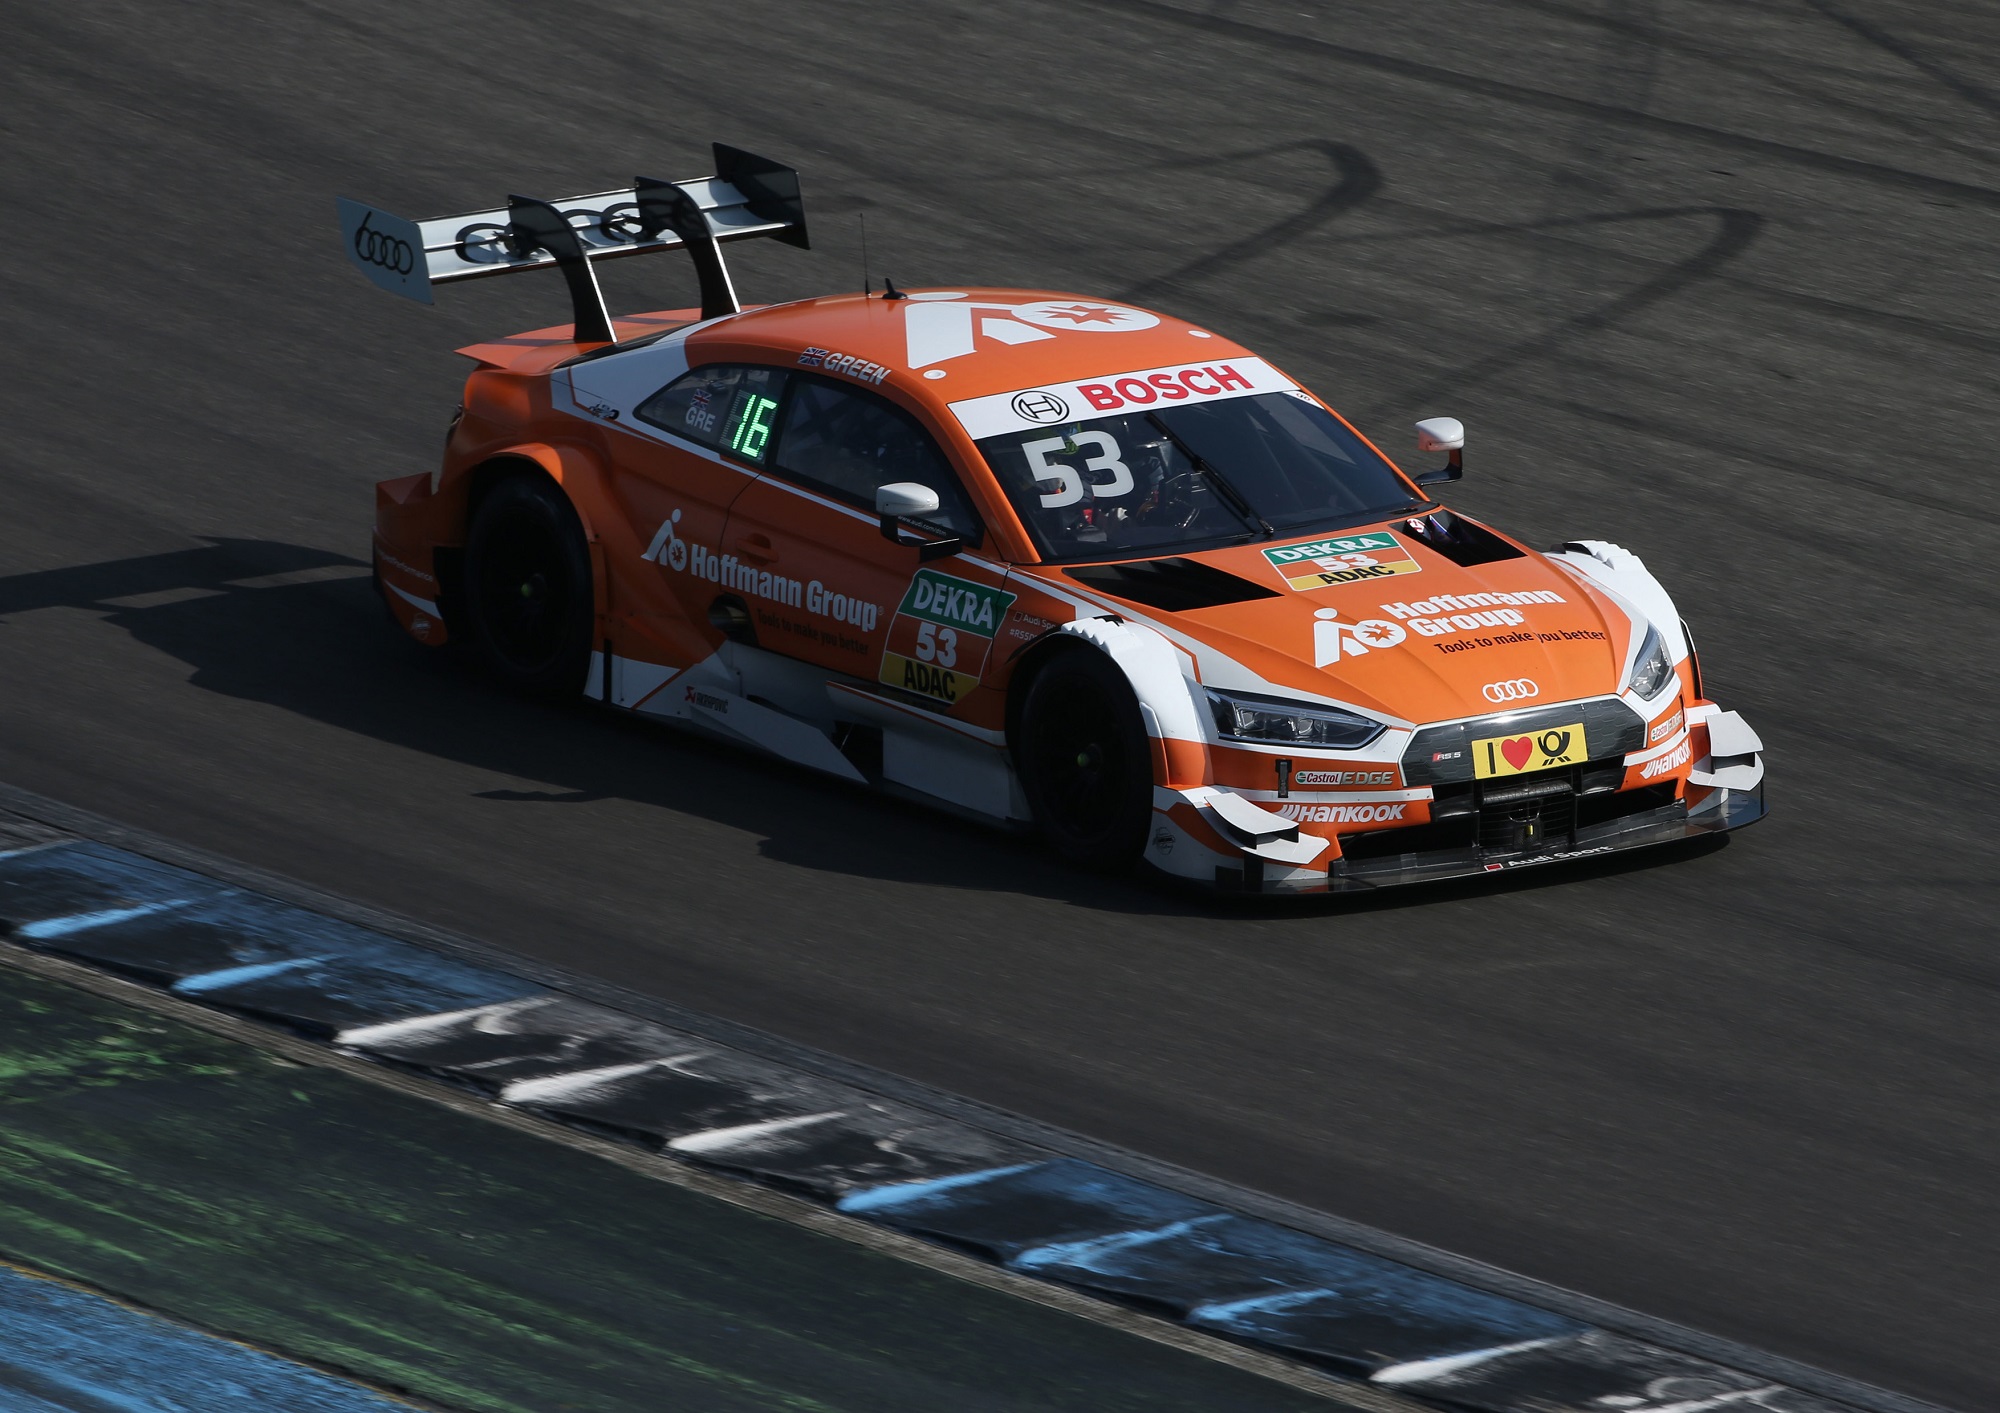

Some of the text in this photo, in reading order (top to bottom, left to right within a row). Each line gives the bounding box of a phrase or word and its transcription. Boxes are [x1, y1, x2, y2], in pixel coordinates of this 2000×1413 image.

[823, 352, 891, 385] GREEN
[1076, 365, 1255, 411] BOSCH
[685, 406, 716, 433] GRE
[732, 394, 778, 458] 16
[1022, 430, 1134, 509] 53
[1270, 537, 1402, 561] DEKRA
[1311, 553, 1389, 571] 53
[691, 543, 802, 609] Hoffmann
[1328, 565, 1405, 584] ADAC
[913, 577, 993, 630] DEKRA
[1023, 614, 1041, 626] Audi
[1379, 590, 1567, 620] Hoffmann
[757, 608, 869, 656] Tools to make you better
[915, 621, 957, 668] 53
[1434, 629, 1607, 655] Tools to make you better
[904, 660, 956, 701] ADAC
[1487, 742, 1496, 775] I
[1307, 772, 1395, 785] Castrol EDGE
[1508, 846, 1613, 867] Audi Sport
